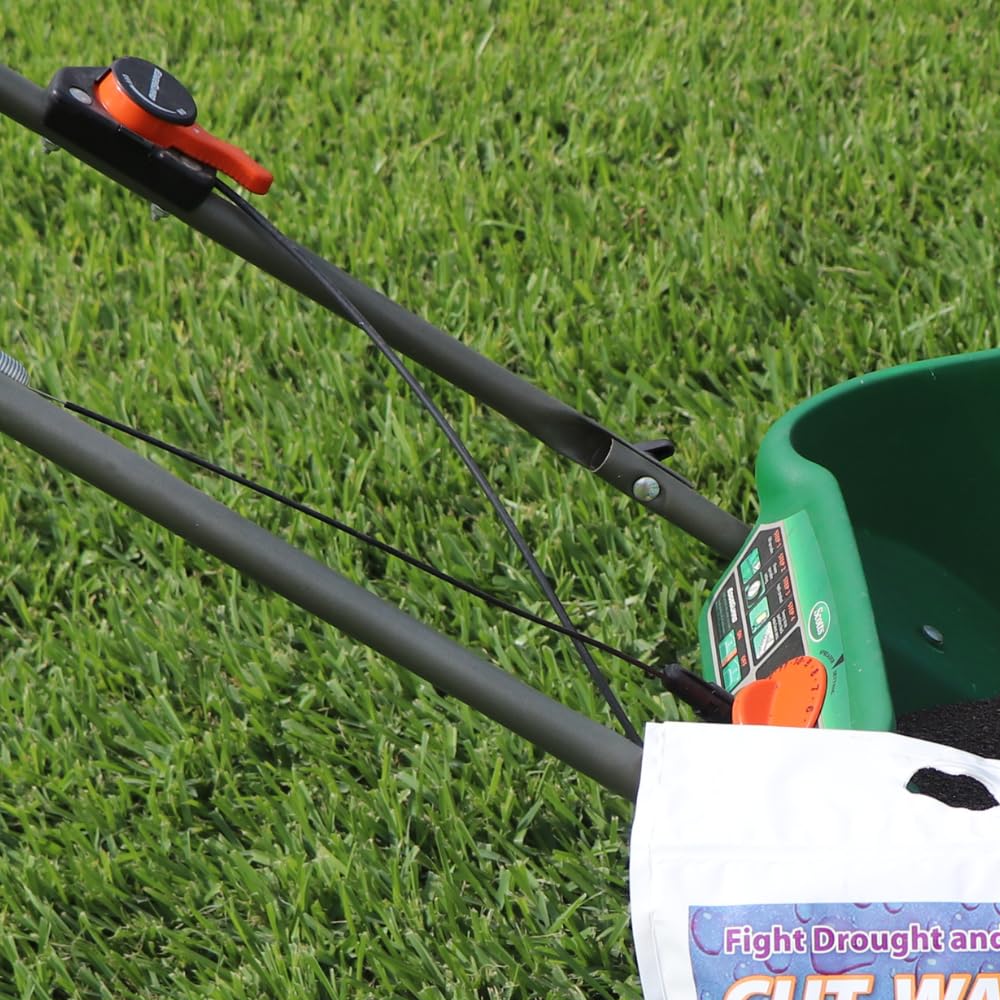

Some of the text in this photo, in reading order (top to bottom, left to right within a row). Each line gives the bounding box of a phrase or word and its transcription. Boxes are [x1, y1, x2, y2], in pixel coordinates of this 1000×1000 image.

[812, 606, 826, 636] Scotts
[725, 924, 806, 960] Fight
[812, 923, 944, 959] Drought
